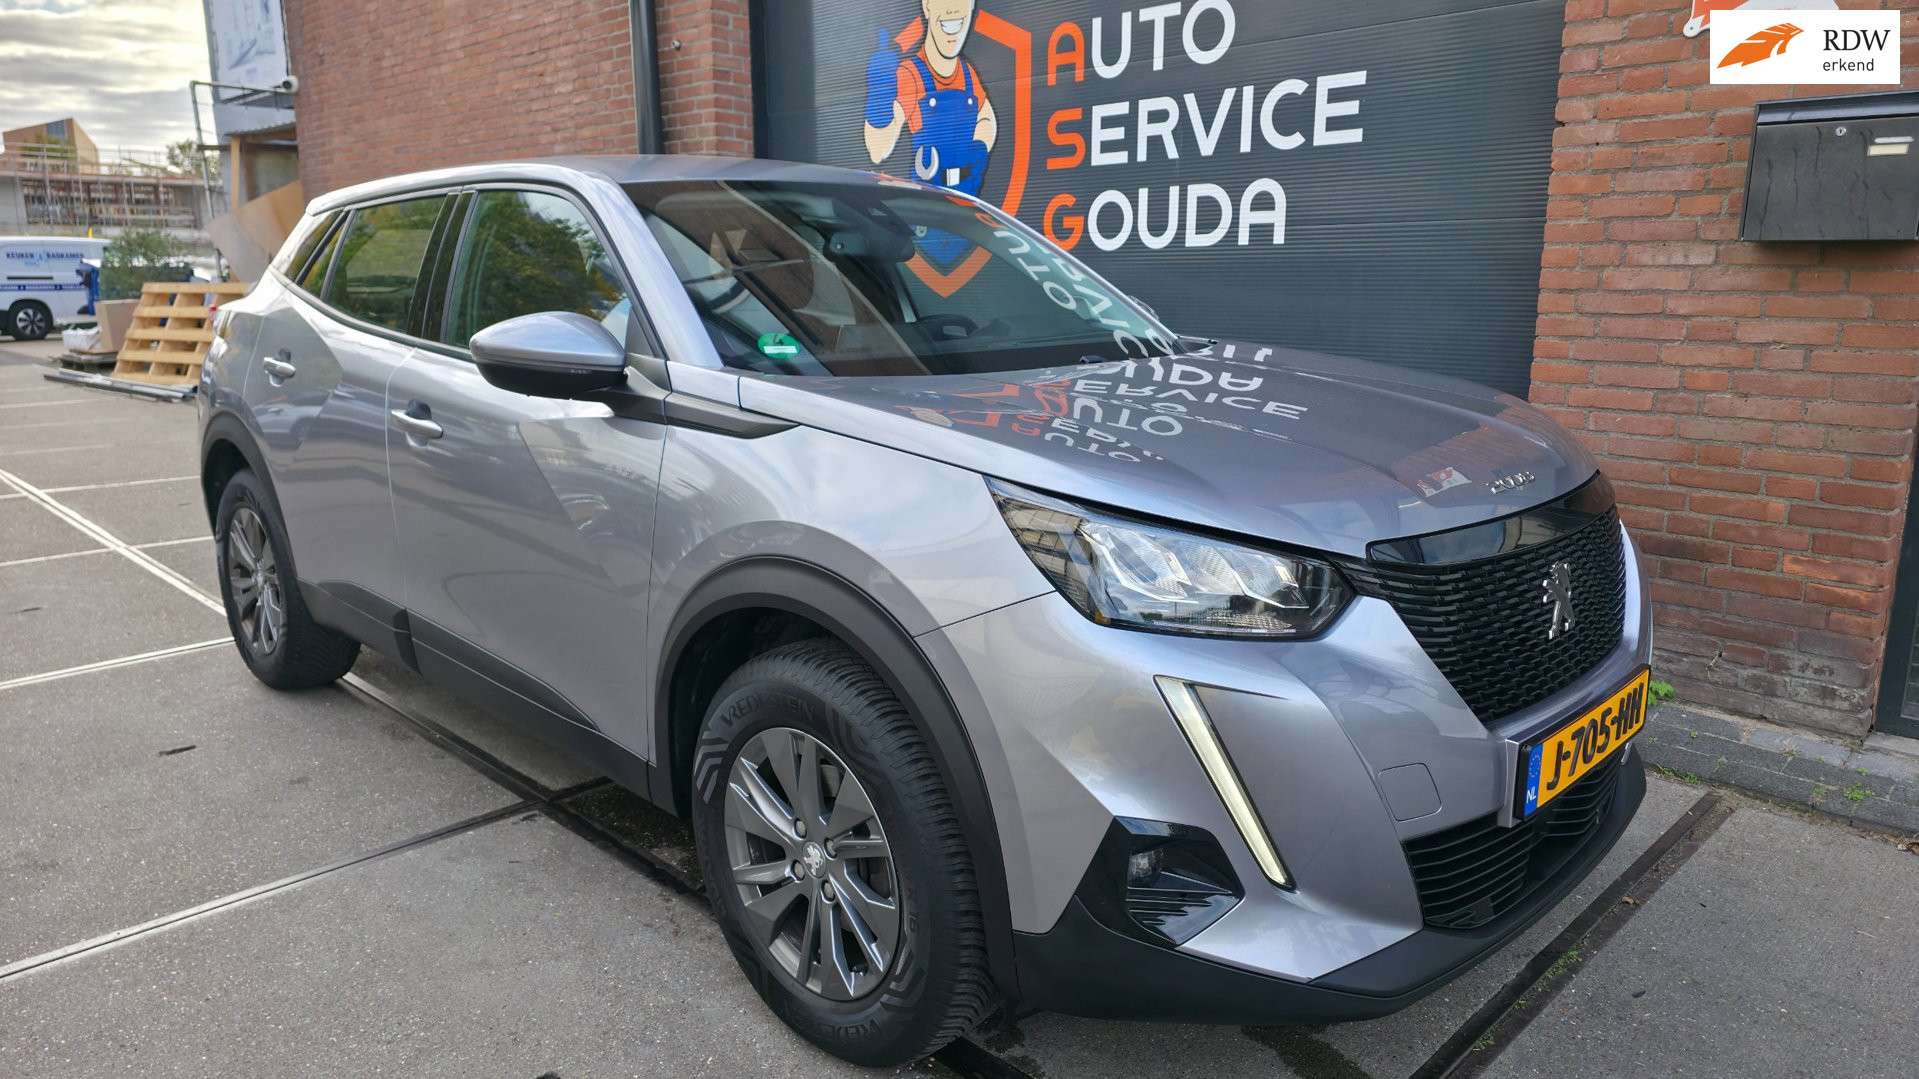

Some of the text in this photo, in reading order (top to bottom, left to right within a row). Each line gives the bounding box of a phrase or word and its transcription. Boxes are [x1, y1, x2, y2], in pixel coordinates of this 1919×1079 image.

[1047, 0, 1236, 86] AUTO
[1046, 70, 1368, 170] SERVICE
[1042, 177, 1288, 251] GOUDA
[1546, 682, 1644, 790] J-705-HN
[1526, 786, 1537, 804] NL
